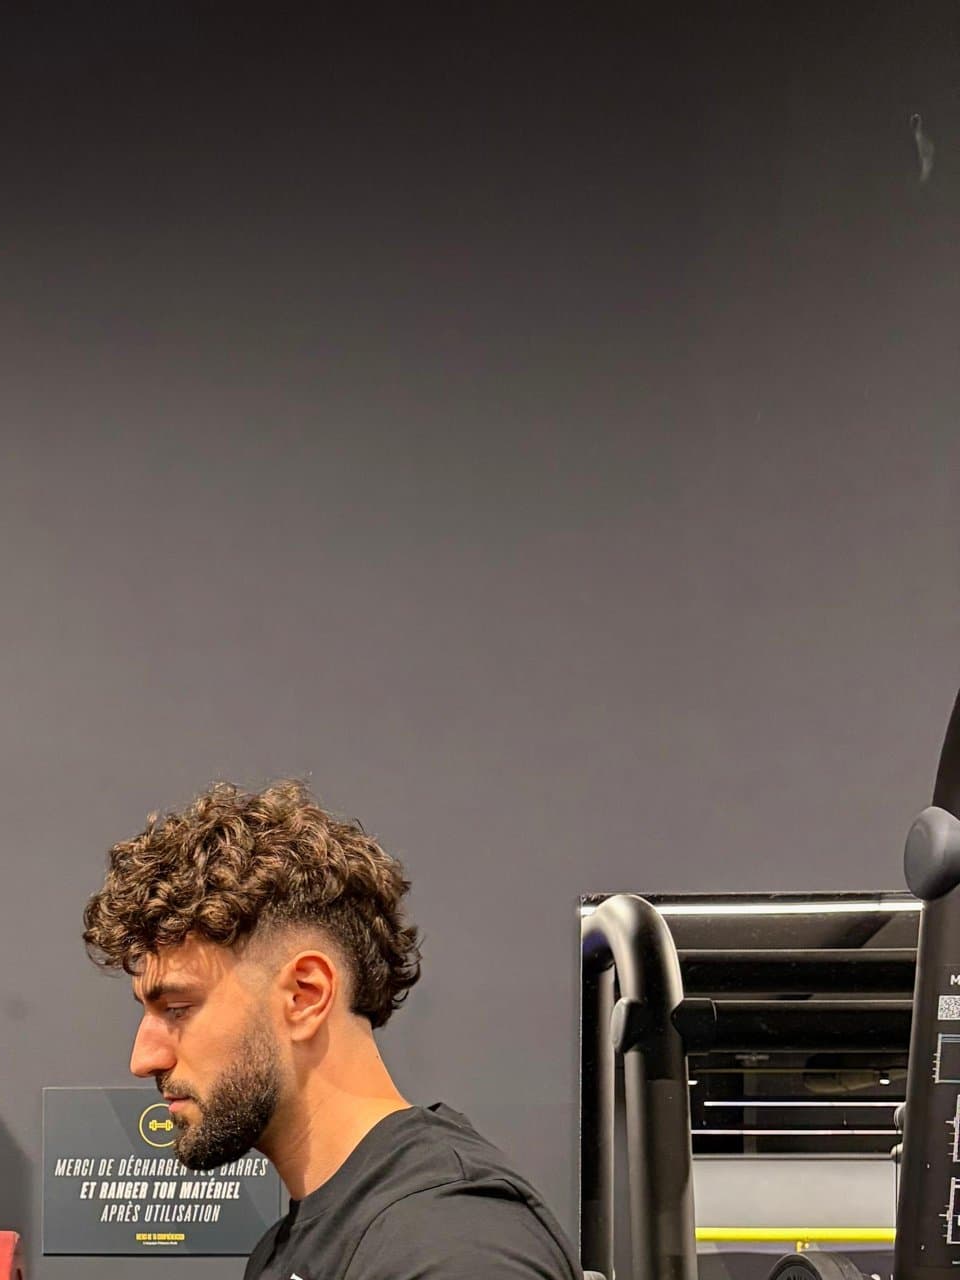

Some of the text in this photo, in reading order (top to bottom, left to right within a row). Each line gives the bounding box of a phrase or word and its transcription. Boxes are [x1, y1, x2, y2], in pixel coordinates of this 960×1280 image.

[54, 1159, 94, 1177] MERCI
[98, 1159, 114, 1177] DE
[220, 1158, 268, 1177] BARRES
[80, 1176, 241, 1200] ET RANGER TON MATÉRIEL
[100, 1200, 221, 1223] APRÈS UTILISATION
